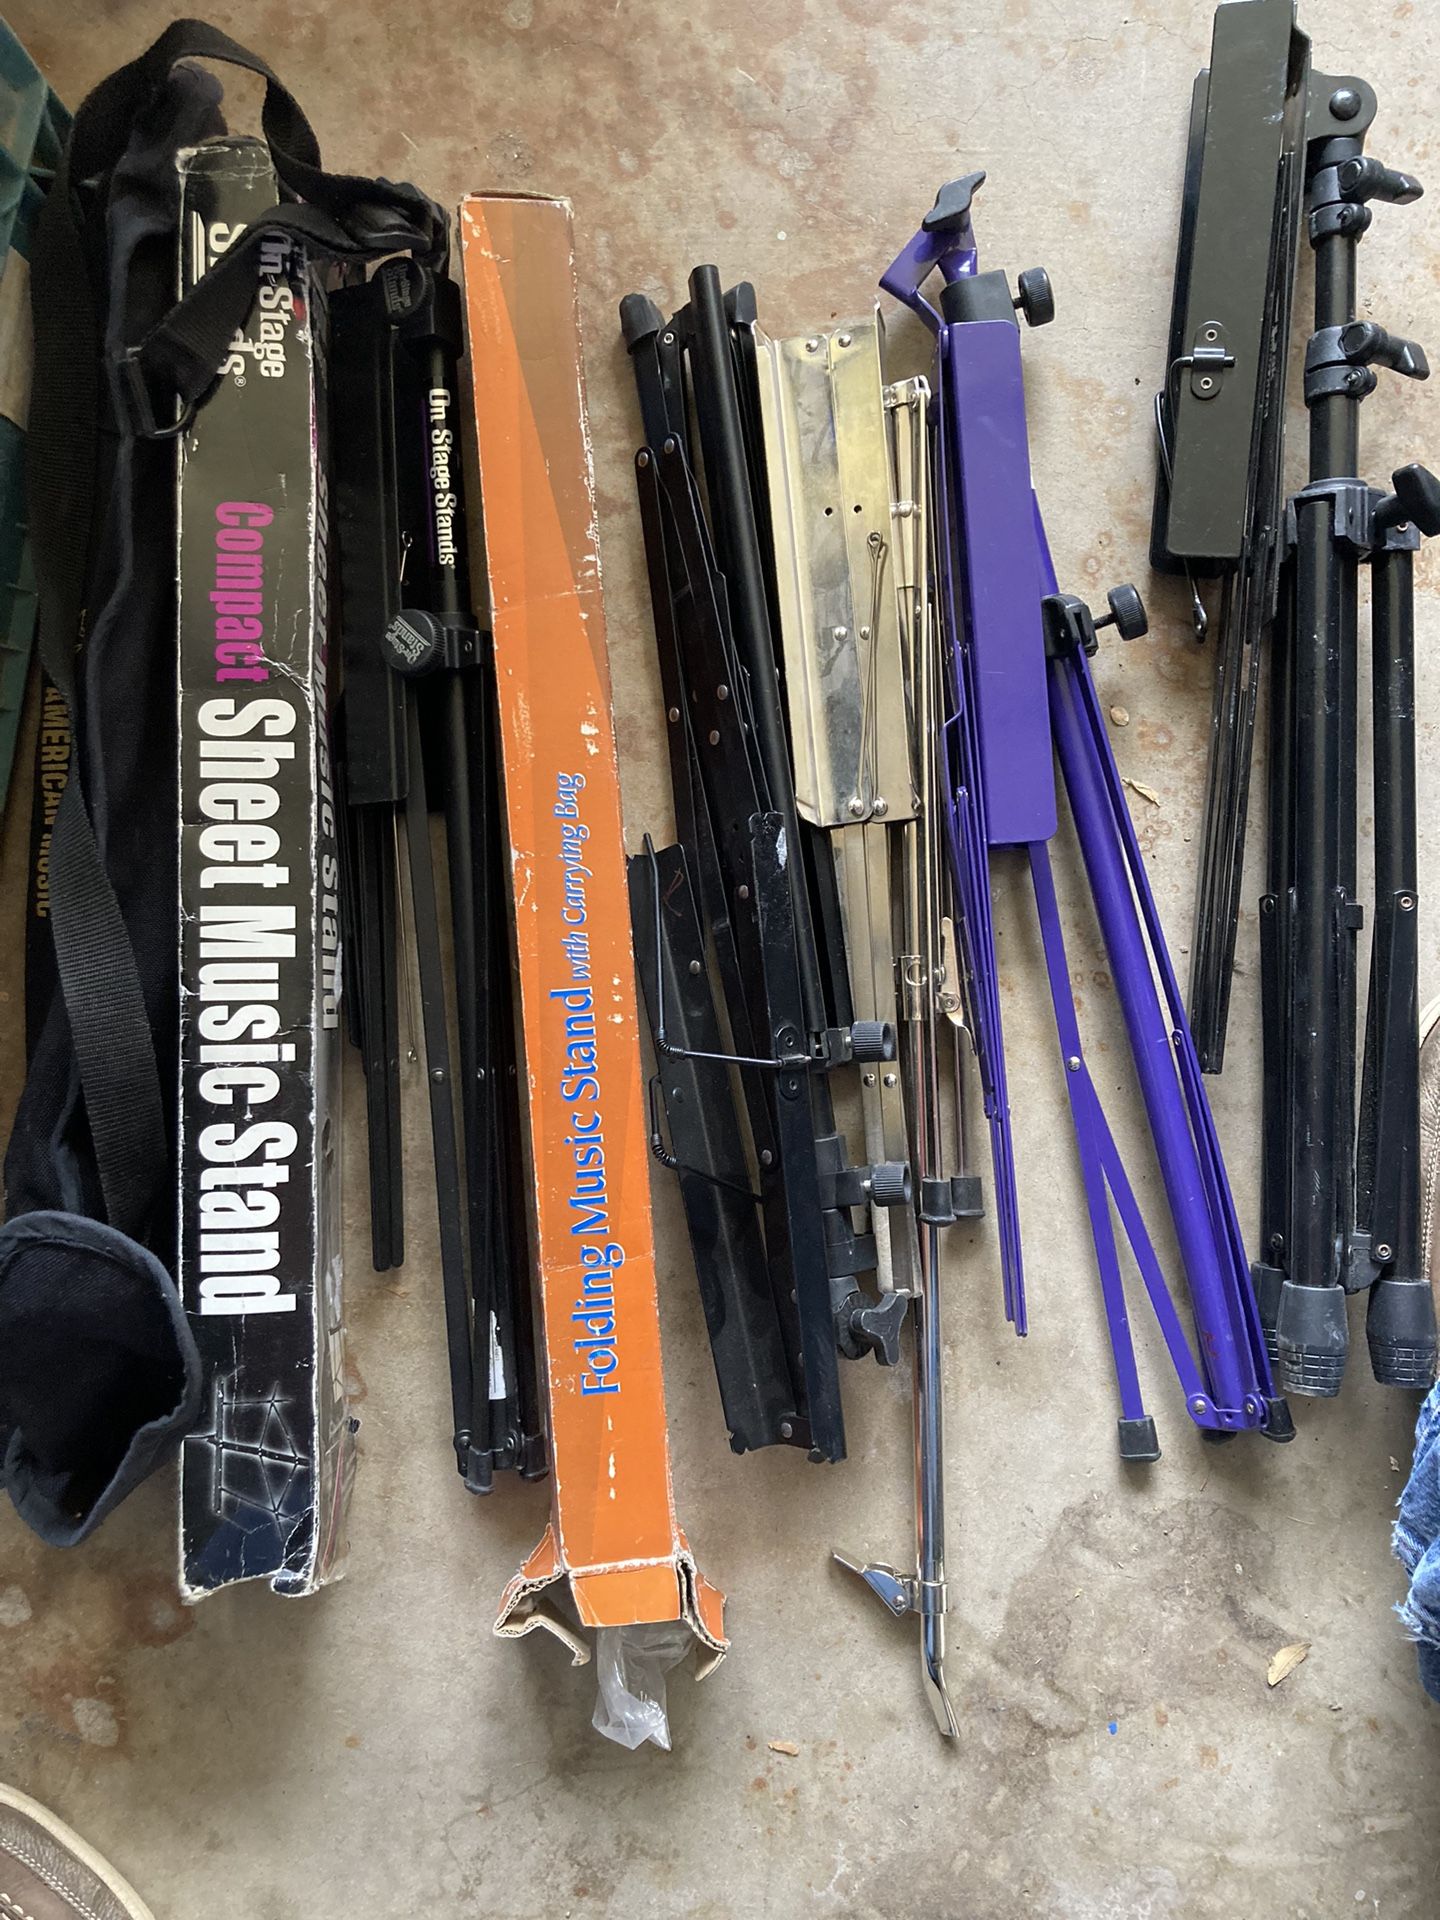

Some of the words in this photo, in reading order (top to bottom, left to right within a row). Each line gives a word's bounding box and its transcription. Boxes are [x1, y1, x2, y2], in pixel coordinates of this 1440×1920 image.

[429, 388, 451, 423] On
[430, 428, 454, 490] Stage
[434, 492, 456, 568] Stands
[209, 502, 274, 682] Compact
[198, 698, 297, 889] Sheet
[554, 770, 586, 819] Bag
[556, 822, 593, 925] Carrying
[198, 905, 297, 1106] Music
[560, 932, 591, 980] with
[549, 986, 601, 1102] Stand
[198, 1120, 299, 1317] Stand
[563, 1109, 609, 1237] Music
[571, 1242, 625, 1396] Folding
